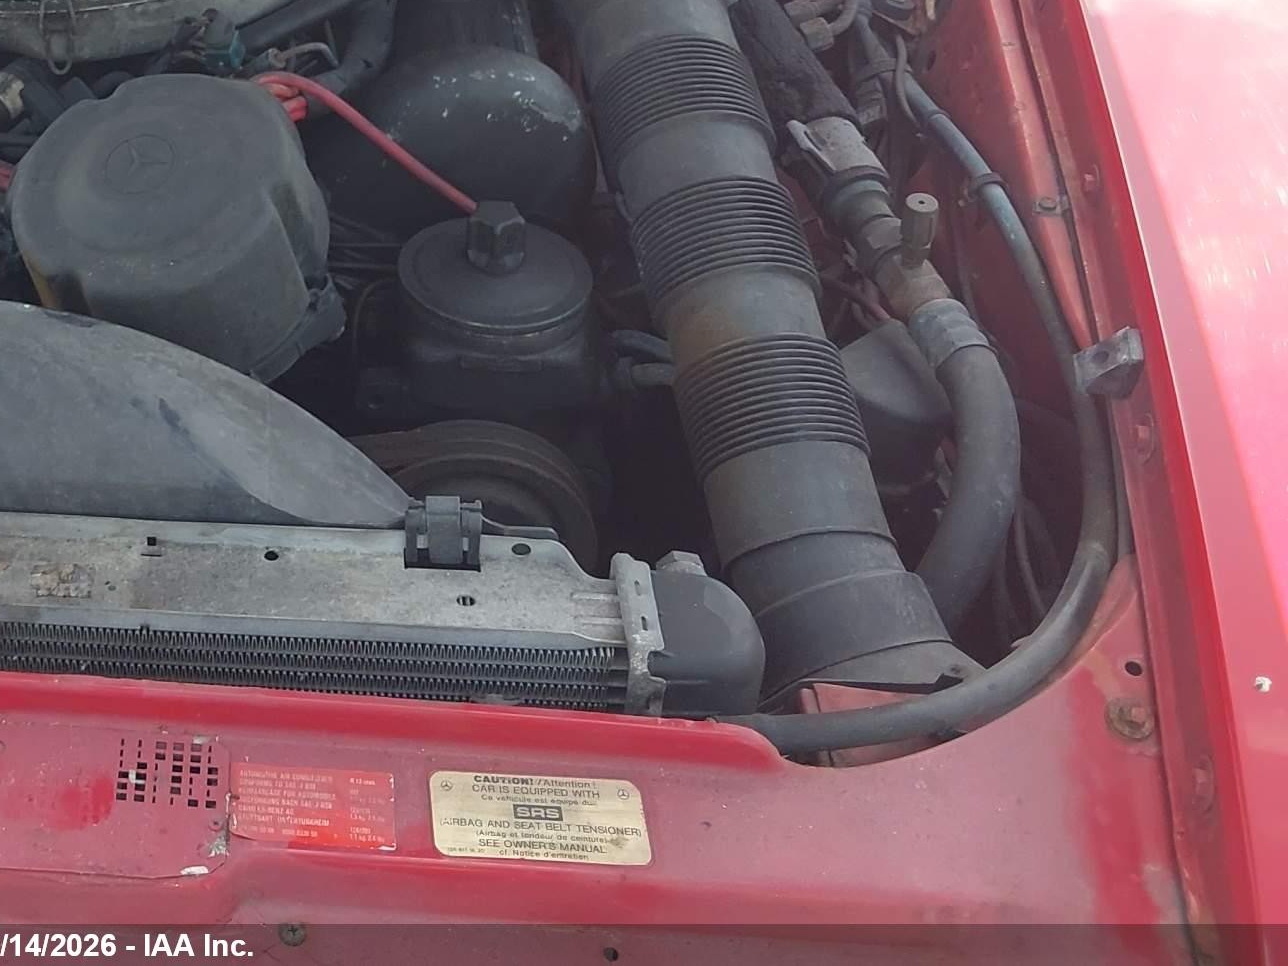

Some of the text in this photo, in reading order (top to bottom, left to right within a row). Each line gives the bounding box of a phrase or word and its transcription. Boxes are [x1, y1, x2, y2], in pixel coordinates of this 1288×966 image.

[472, 784, 600, 799] CAR IS EQUIPPED WITH
[515, 807, 561, 819] SRS
[487, 820, 510, 829] AND
[514, 821, 541, 830] SEAT
[545, 823, 571, 832] BELT
[575, 824, 642, 837] TENSIONER)
[479, 839, 606, 854] SEE OWNER'S MANUAL
